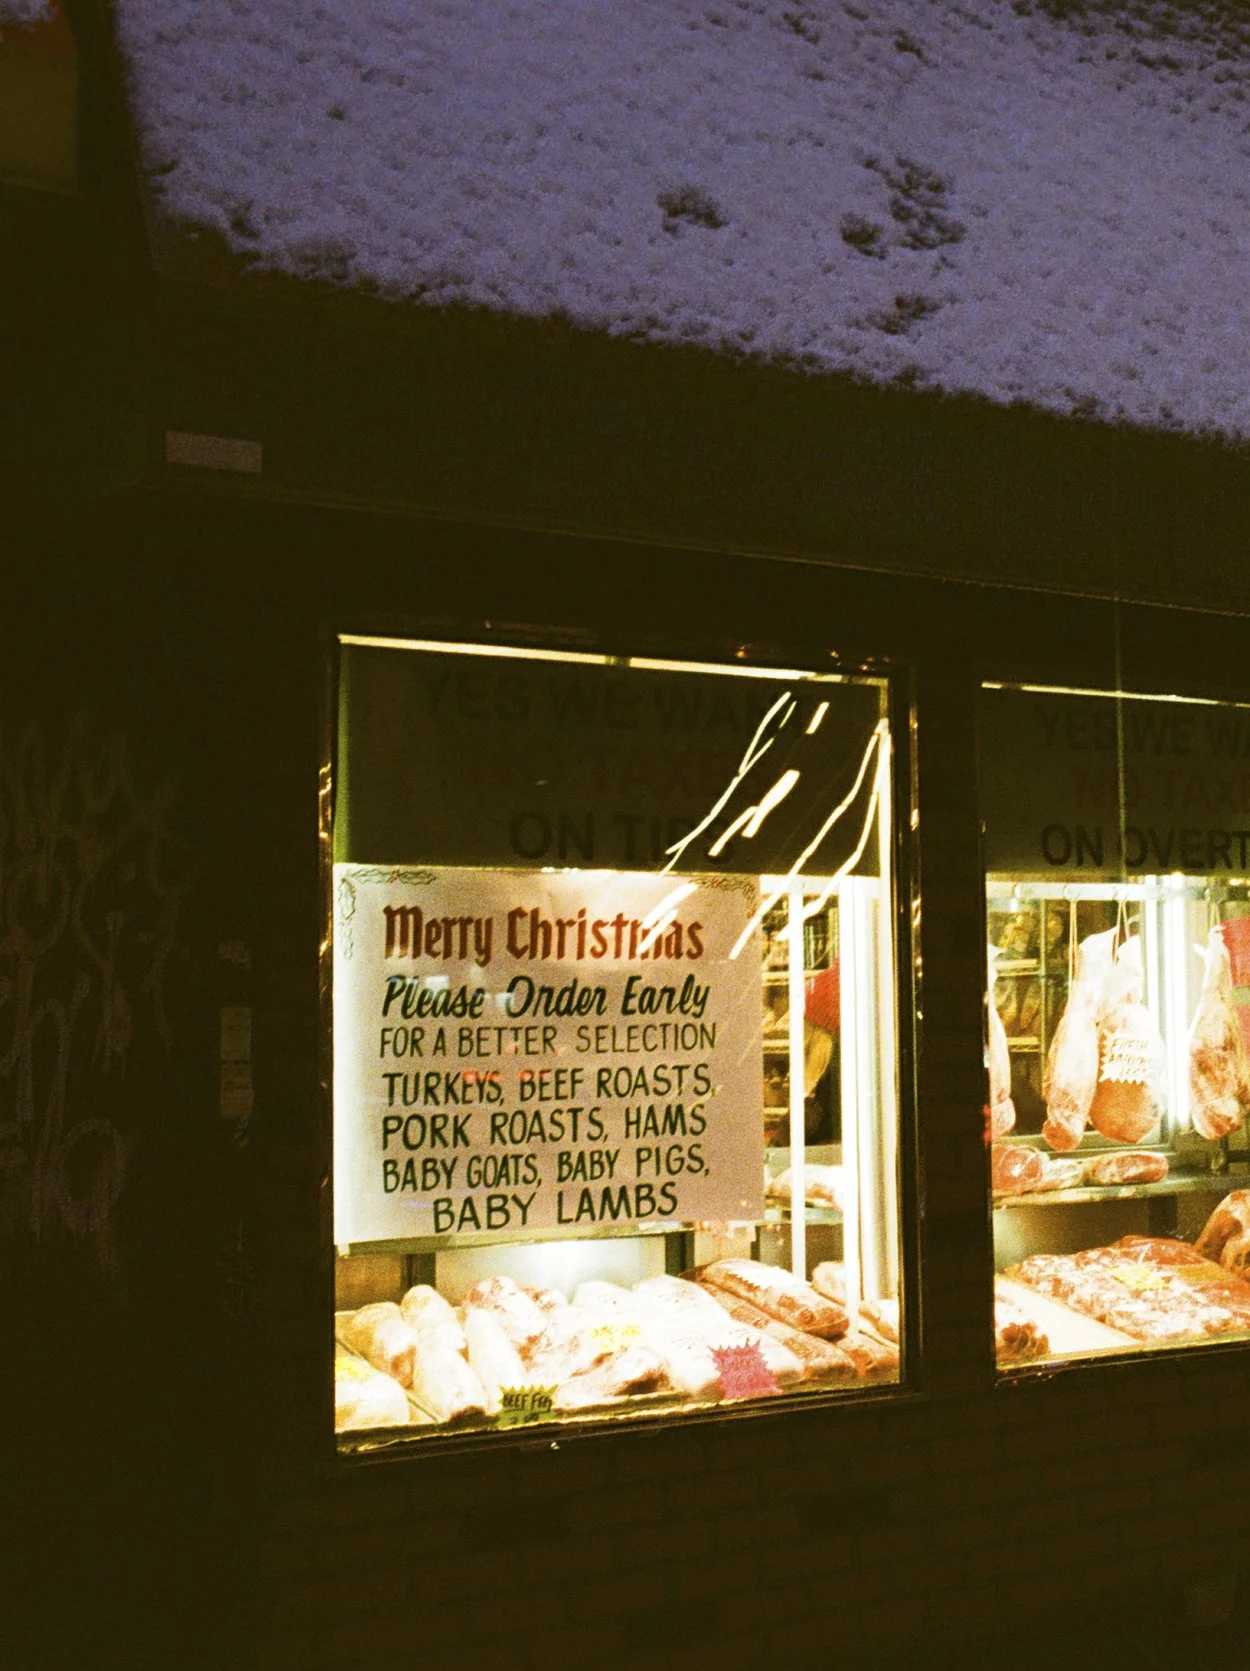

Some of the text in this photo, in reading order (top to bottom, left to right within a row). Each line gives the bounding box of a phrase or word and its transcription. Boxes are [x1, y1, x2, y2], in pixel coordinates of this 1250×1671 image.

[417, 666, 531, 721] YES
[547, 681, 640, 731] WE
[1035, 705, 1117, 751] YES
[1128, 711, 1195, 755] WE
[509, 810, 596, 862] ON
[1041, 824, 1103, 867] ON
[384, 905, 704, 966] Merry Christmas
[382, 974, 710, 1019] Please Order Early
[380, 1022, 716, 1059] FOR A BETTER SELECTION
[519, 1067, 584, 1102] BEEF
[382, 1103, 707, 1151] PORK ROASTS, HAMS
[382, 1143, 710, 1194] BABY GOATS, BABY PIGS,
[433, 1182, 678, 1234] BABY LAMBS
